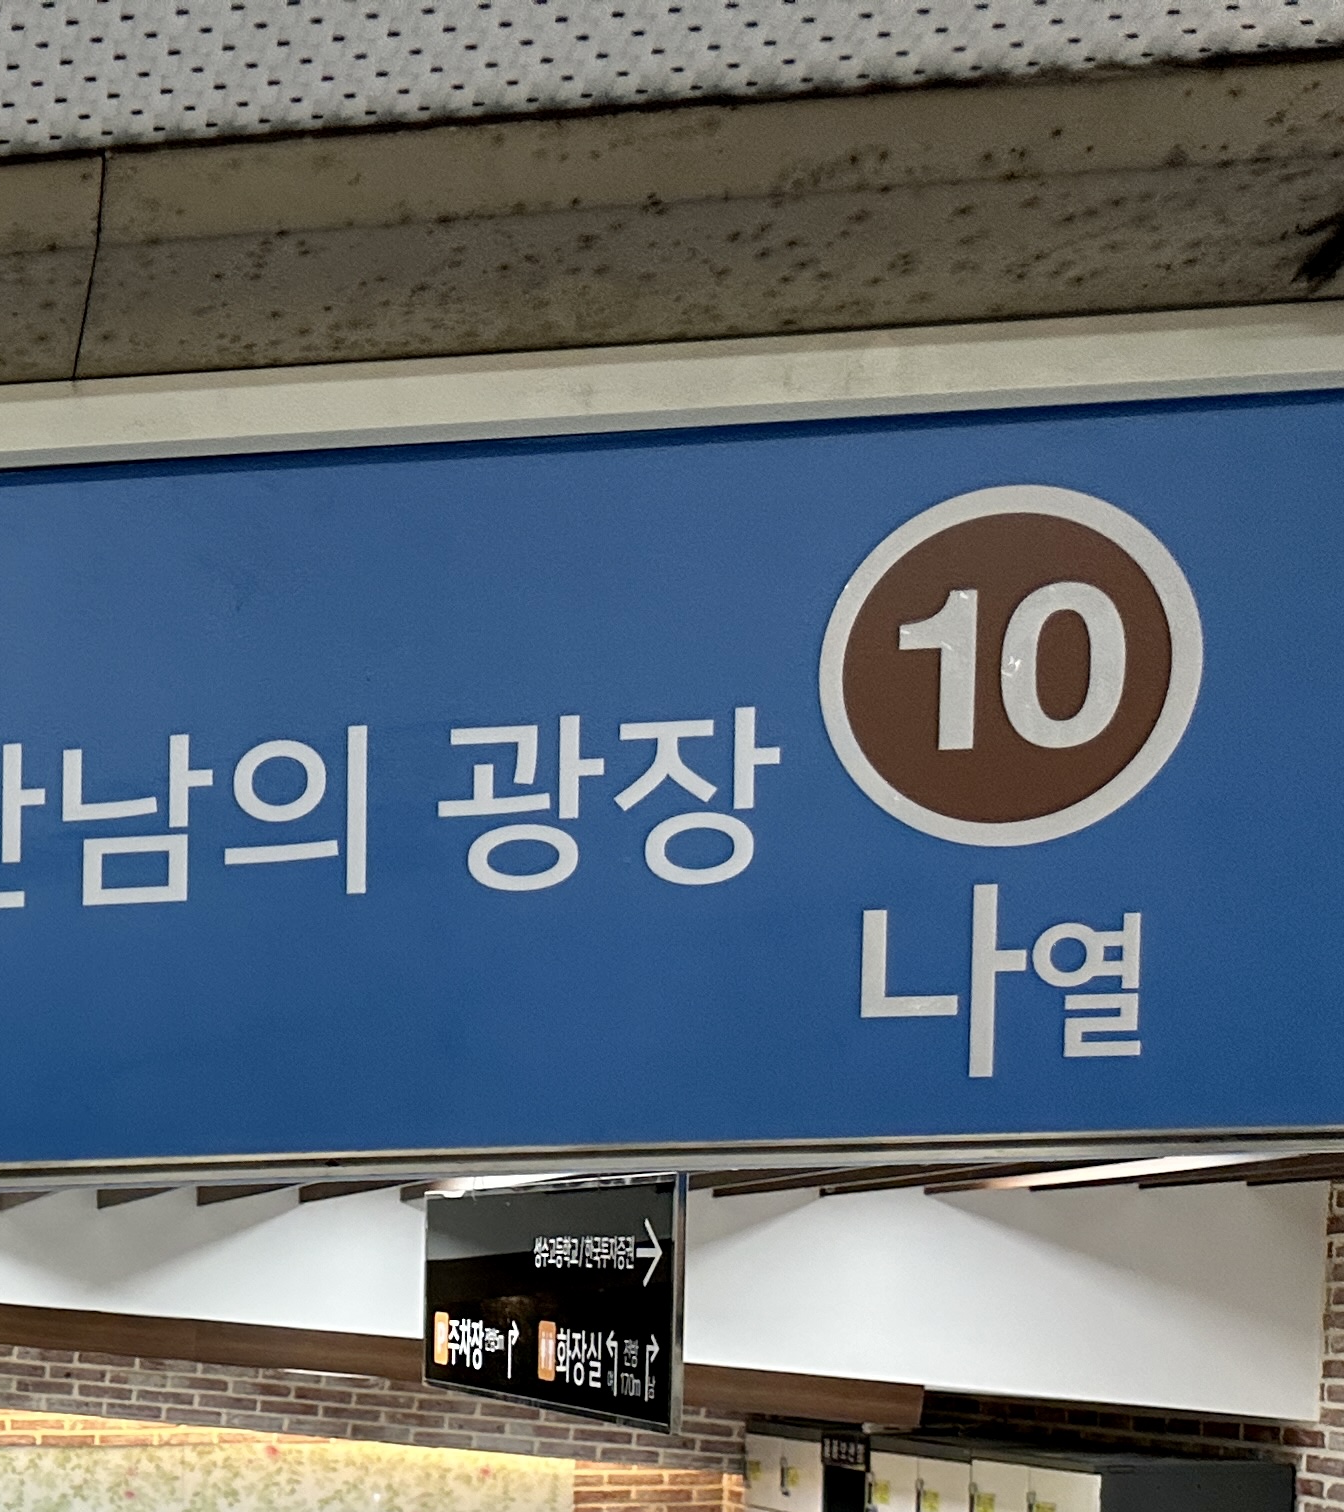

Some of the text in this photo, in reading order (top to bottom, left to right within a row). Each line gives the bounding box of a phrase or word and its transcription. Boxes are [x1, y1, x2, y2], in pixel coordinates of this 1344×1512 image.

[898, 581, 1127, 751] 10
[438, 706, 781, 892] 광장
[860, 883, 1142, 1078] 나열
[447, 1318, 485, 1371] 주차장
[555, 1327, 603, 1389] 화장실
[620, 1372, 641, 1397] 170m
